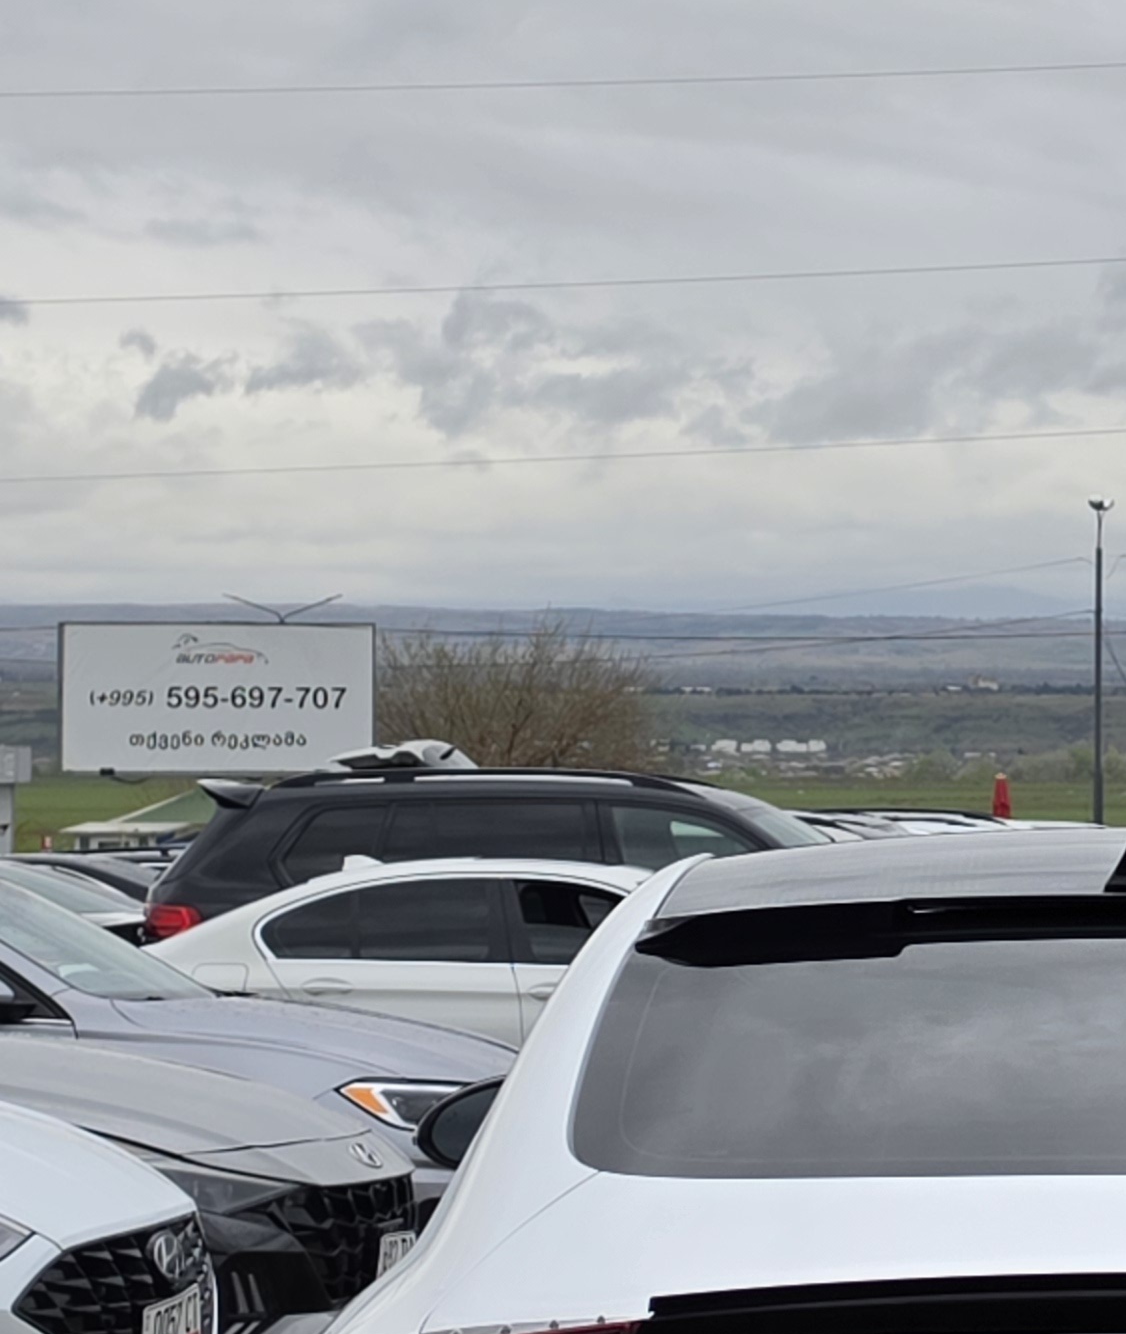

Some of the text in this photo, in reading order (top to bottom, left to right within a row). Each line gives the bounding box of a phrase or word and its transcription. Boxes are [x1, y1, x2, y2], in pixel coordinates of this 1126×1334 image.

[88, 686, 348, 709] (+995) 595-697-707
[129, 730, 308, 750] თქვენი რეკლამა
